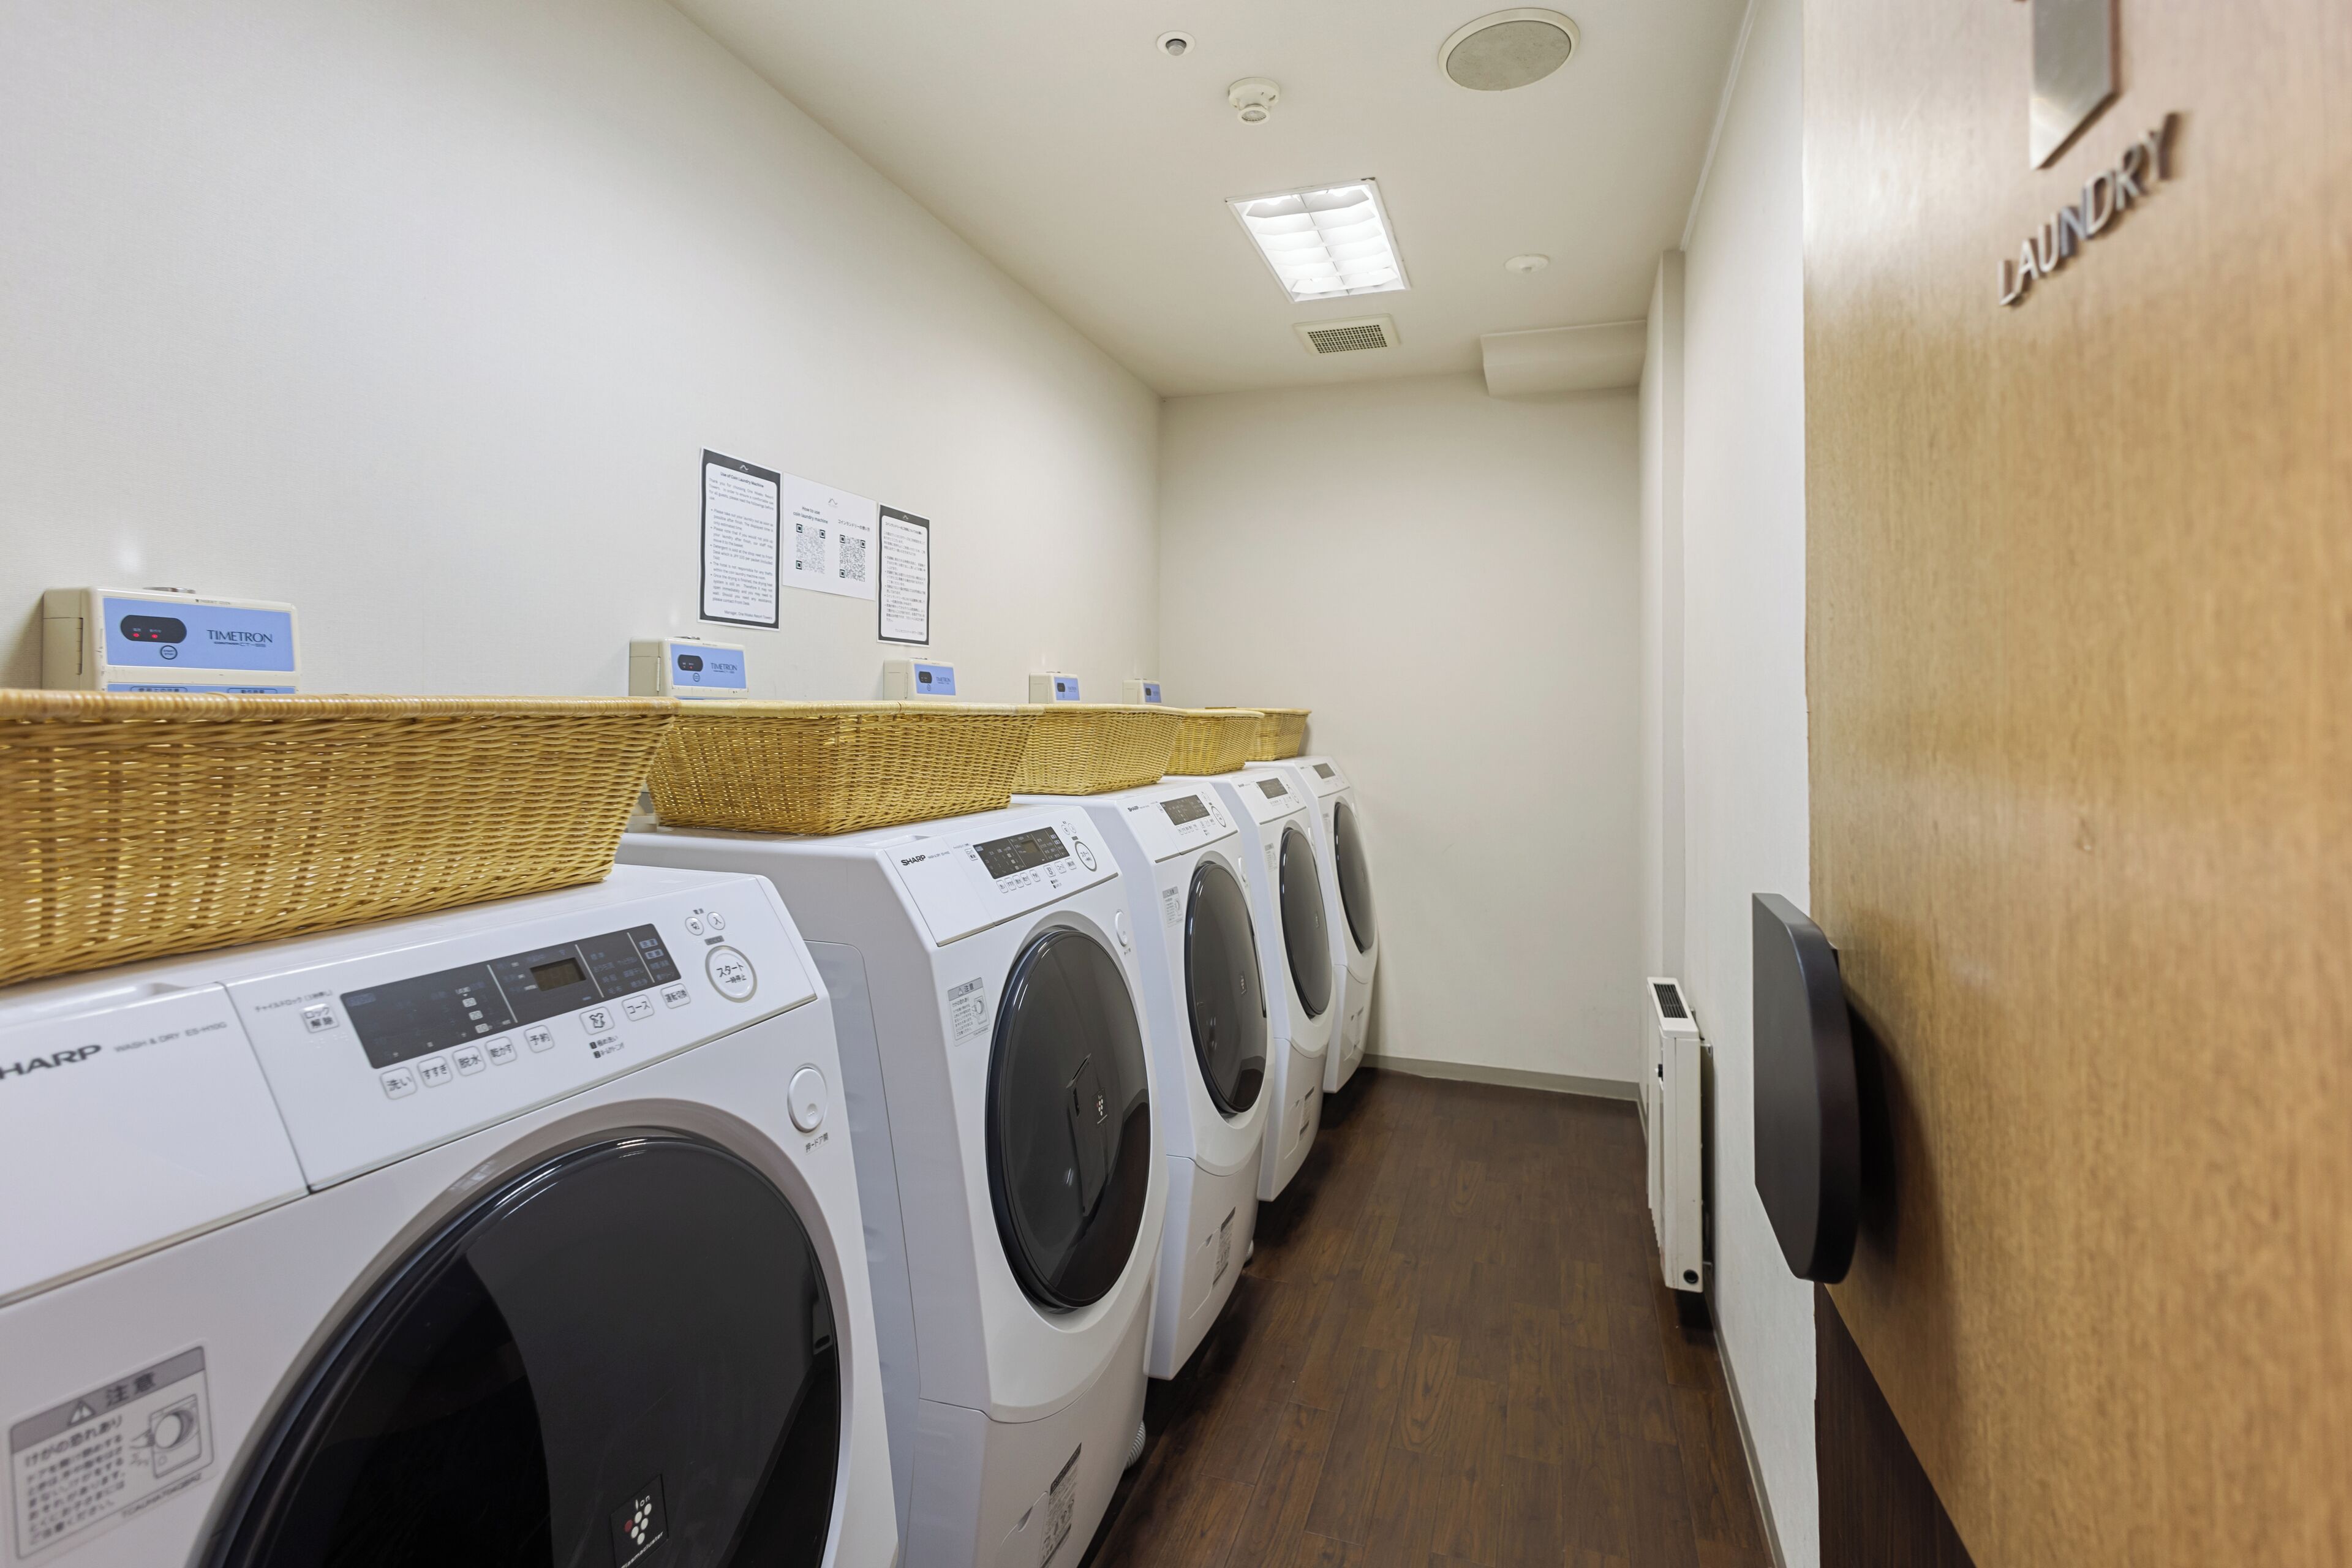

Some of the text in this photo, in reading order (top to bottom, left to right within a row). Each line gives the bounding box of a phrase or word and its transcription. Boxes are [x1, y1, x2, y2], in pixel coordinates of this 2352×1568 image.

[1998, 112, 2182, 307] LAUNDRY
[801, 513, 814, 521] laundry
[206, 629, 273, 643] TIMETRON
[710, 662, 737, 671] TIMETRON
[900, 854, 926, 866] SHARP
[712, 916, 722, 925] 入
[716, 962, 744, 978] スタート
[725, 974, 747, 984] 一時停止
[304, 1007, 330, 1019] ロック
[627, 1001, 650, 1014] コース
[114, 1040, 147, 1053] WASH
[158, 1032, 180, 1043] DRY
[529, 1032, 551, 1046] 予約
[490, 1044, 513, 1058] 乾かす
[0, 1044, 102, 1081] HARP
[458, 1054, 481, 1069] 脱水
[423, 1063, 447, 1080] すすぎ
[386, 1076, 412, 1092] 洗い
[105, 1371, 156, 1408] 注意
[24, 1414, 123, 1467] けがの恐れあり
[635, 1494, 650, 1511] Ion
